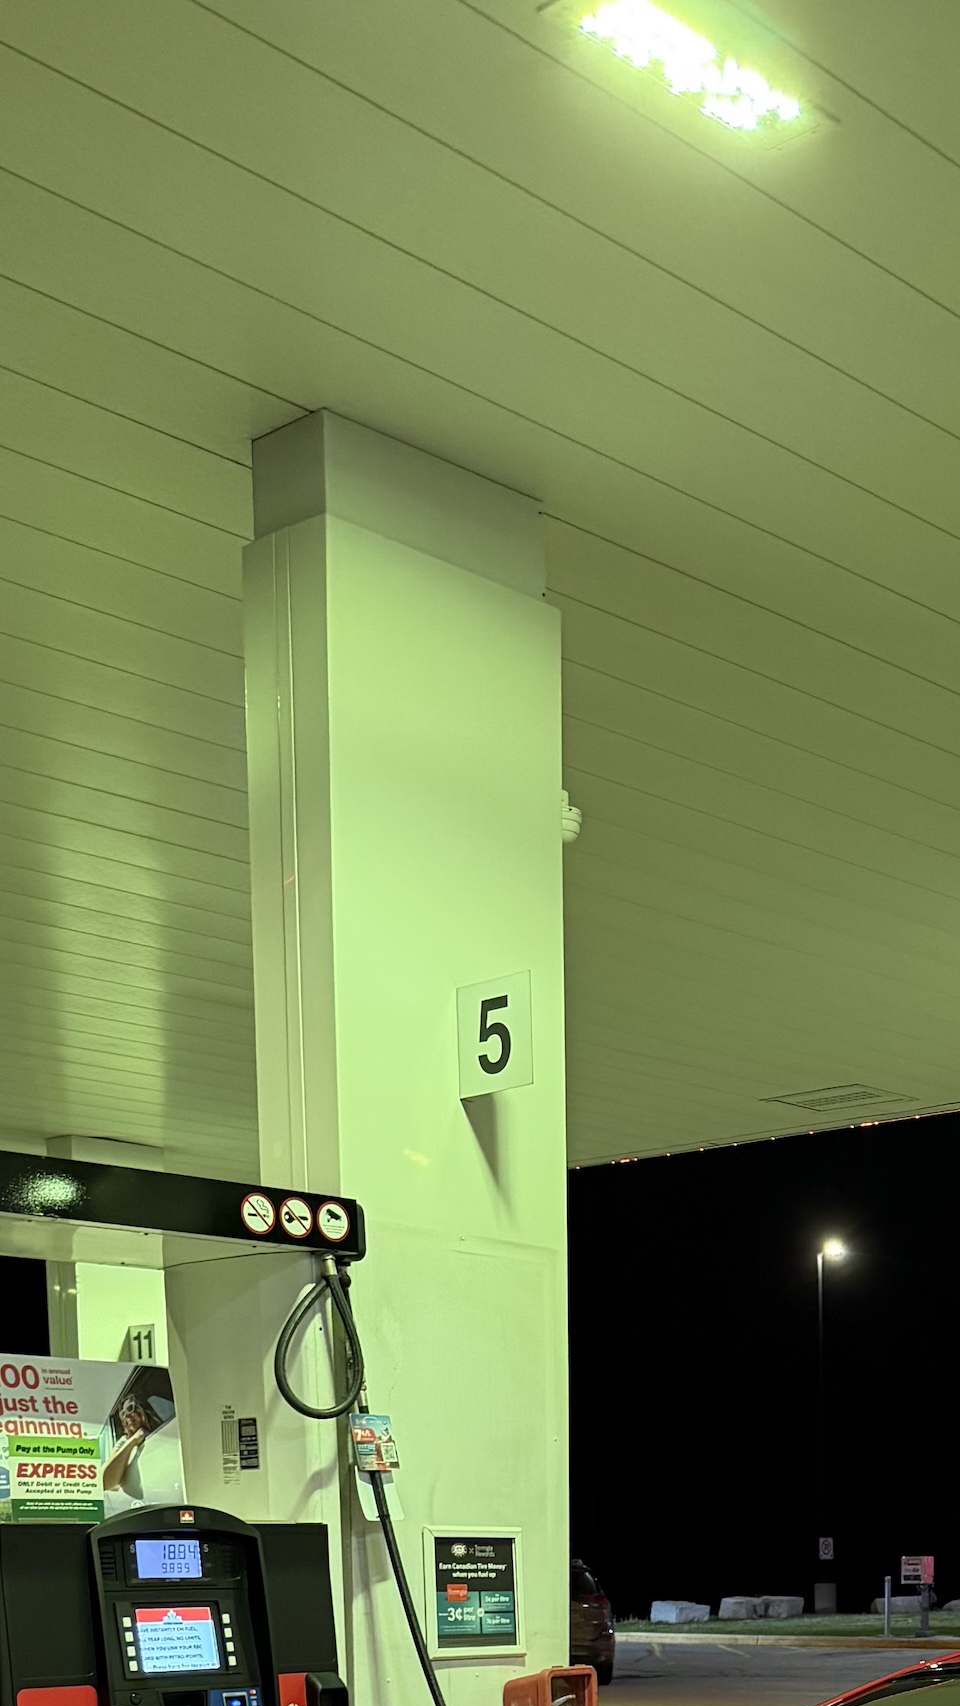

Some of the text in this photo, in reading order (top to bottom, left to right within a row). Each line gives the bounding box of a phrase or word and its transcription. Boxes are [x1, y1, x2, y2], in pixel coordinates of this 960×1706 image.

[478, 995, 511, 1075] 5
[133, 1330, 152, 1359] 11
[43, 1395, 78, 1415] the
[0, 1416, 88, 1438] ginning.
[16, 1444, 31, 1454] Pay
[56, 1446, 77, 1455] Pump
[78, 1447, 94, 1456] Only
[16, 1462, 97, 1480] EXPRESS
[452, 1562, 477, 1570] Canadian
[447, 1607, 462, 1621] 3¢
